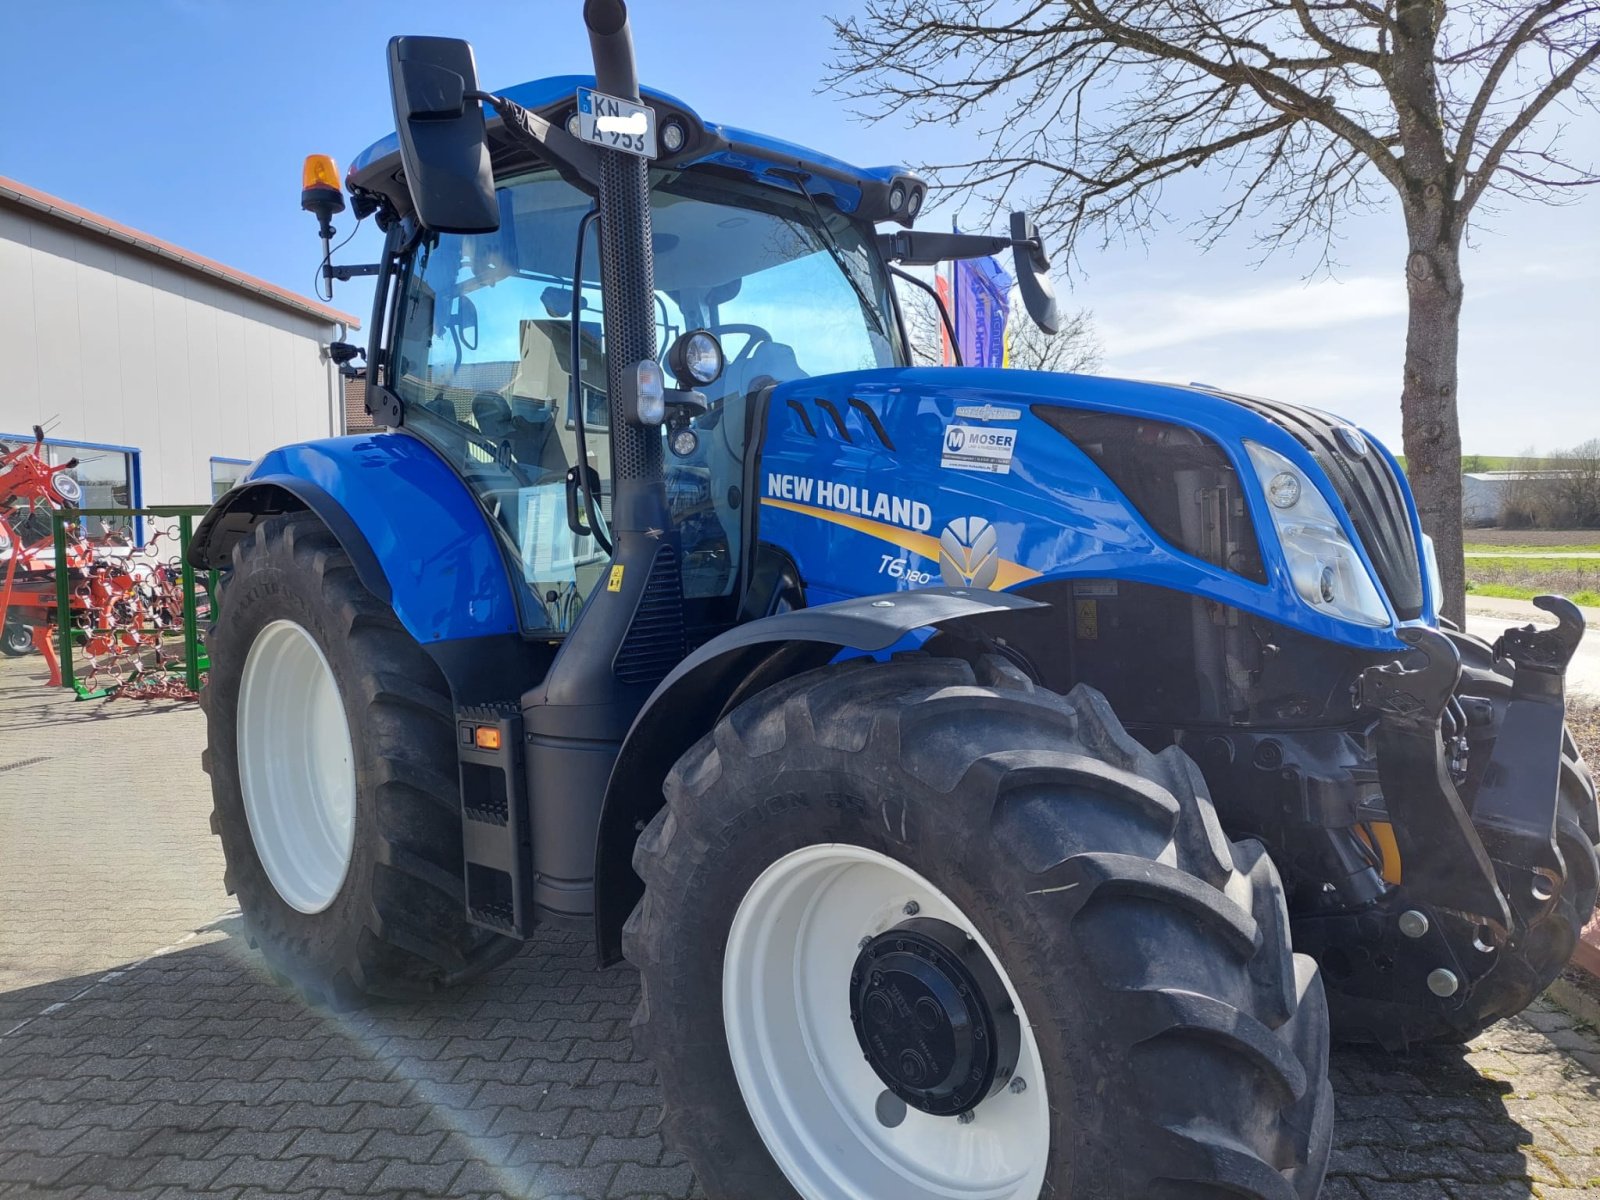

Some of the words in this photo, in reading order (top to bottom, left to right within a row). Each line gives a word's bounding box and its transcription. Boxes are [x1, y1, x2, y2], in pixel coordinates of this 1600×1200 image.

[594, 96, 620, 117] KN
[969, 434, 1013, 447] MOSER
[768, 473, 815, 502] NEW
[818, 480, 932, 532] HOLLAND
[878, 554, 930, 585] T6.180
